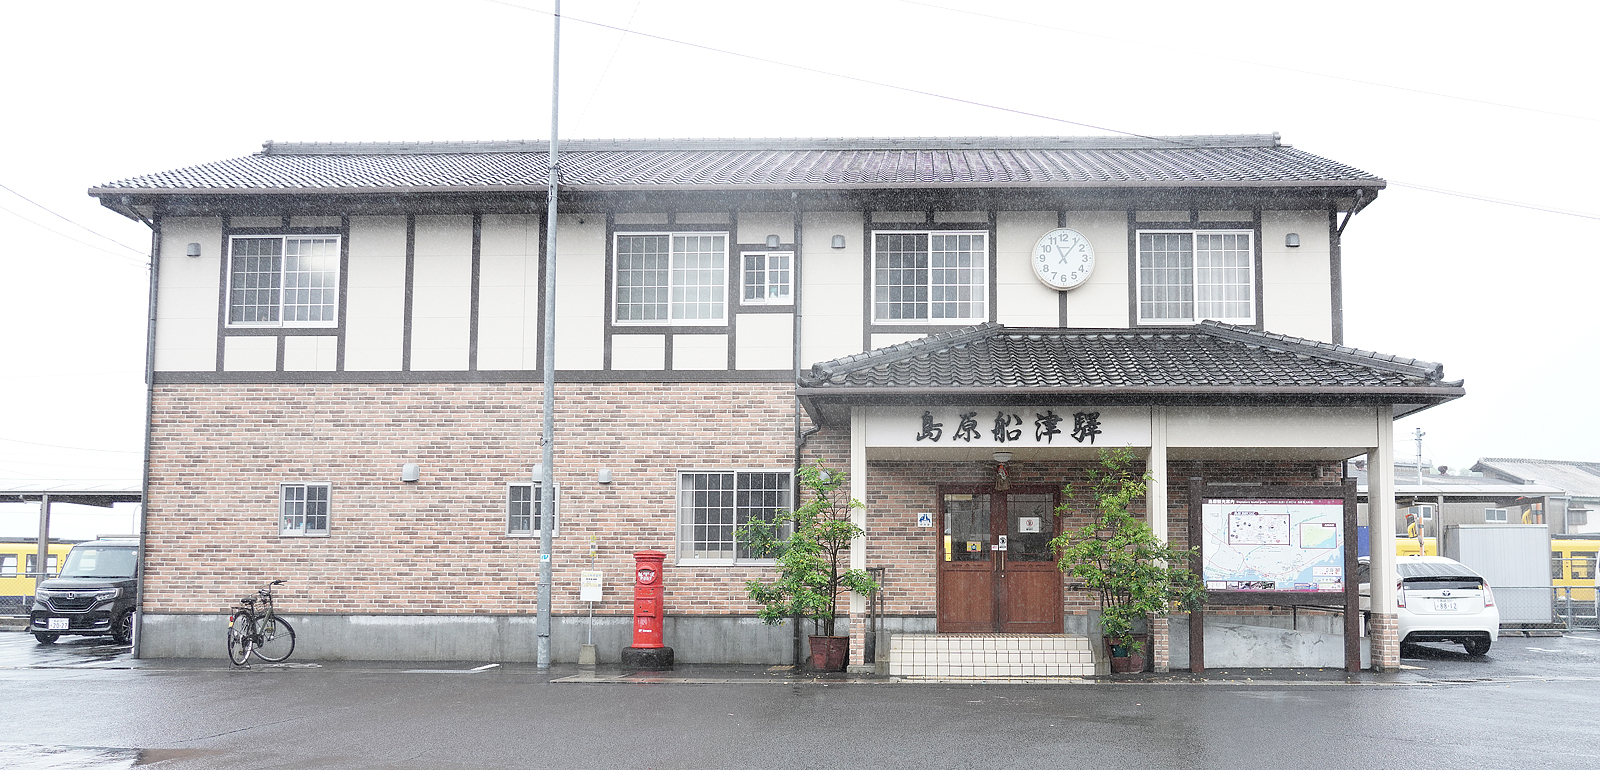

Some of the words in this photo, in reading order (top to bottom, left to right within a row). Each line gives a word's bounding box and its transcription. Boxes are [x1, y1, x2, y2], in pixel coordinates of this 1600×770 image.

[1049, 236, 1057, 245] 11
[1058, 233, 1069, 242] 12
[1042, 244, 1052, 253] 10
[1079, 244, 1085, 252] 2
[1039, 254, 1046, 263] 9
[1082, 254, 1088, 263] 3
[1042, 264, 1049, 273] 8
[1078, 264, 1085, 273] 4
[1051, 271, 1058, 280] 7
[1060, 274, 1067, 283] 6
[1071, 271, 1077, 280] 5
